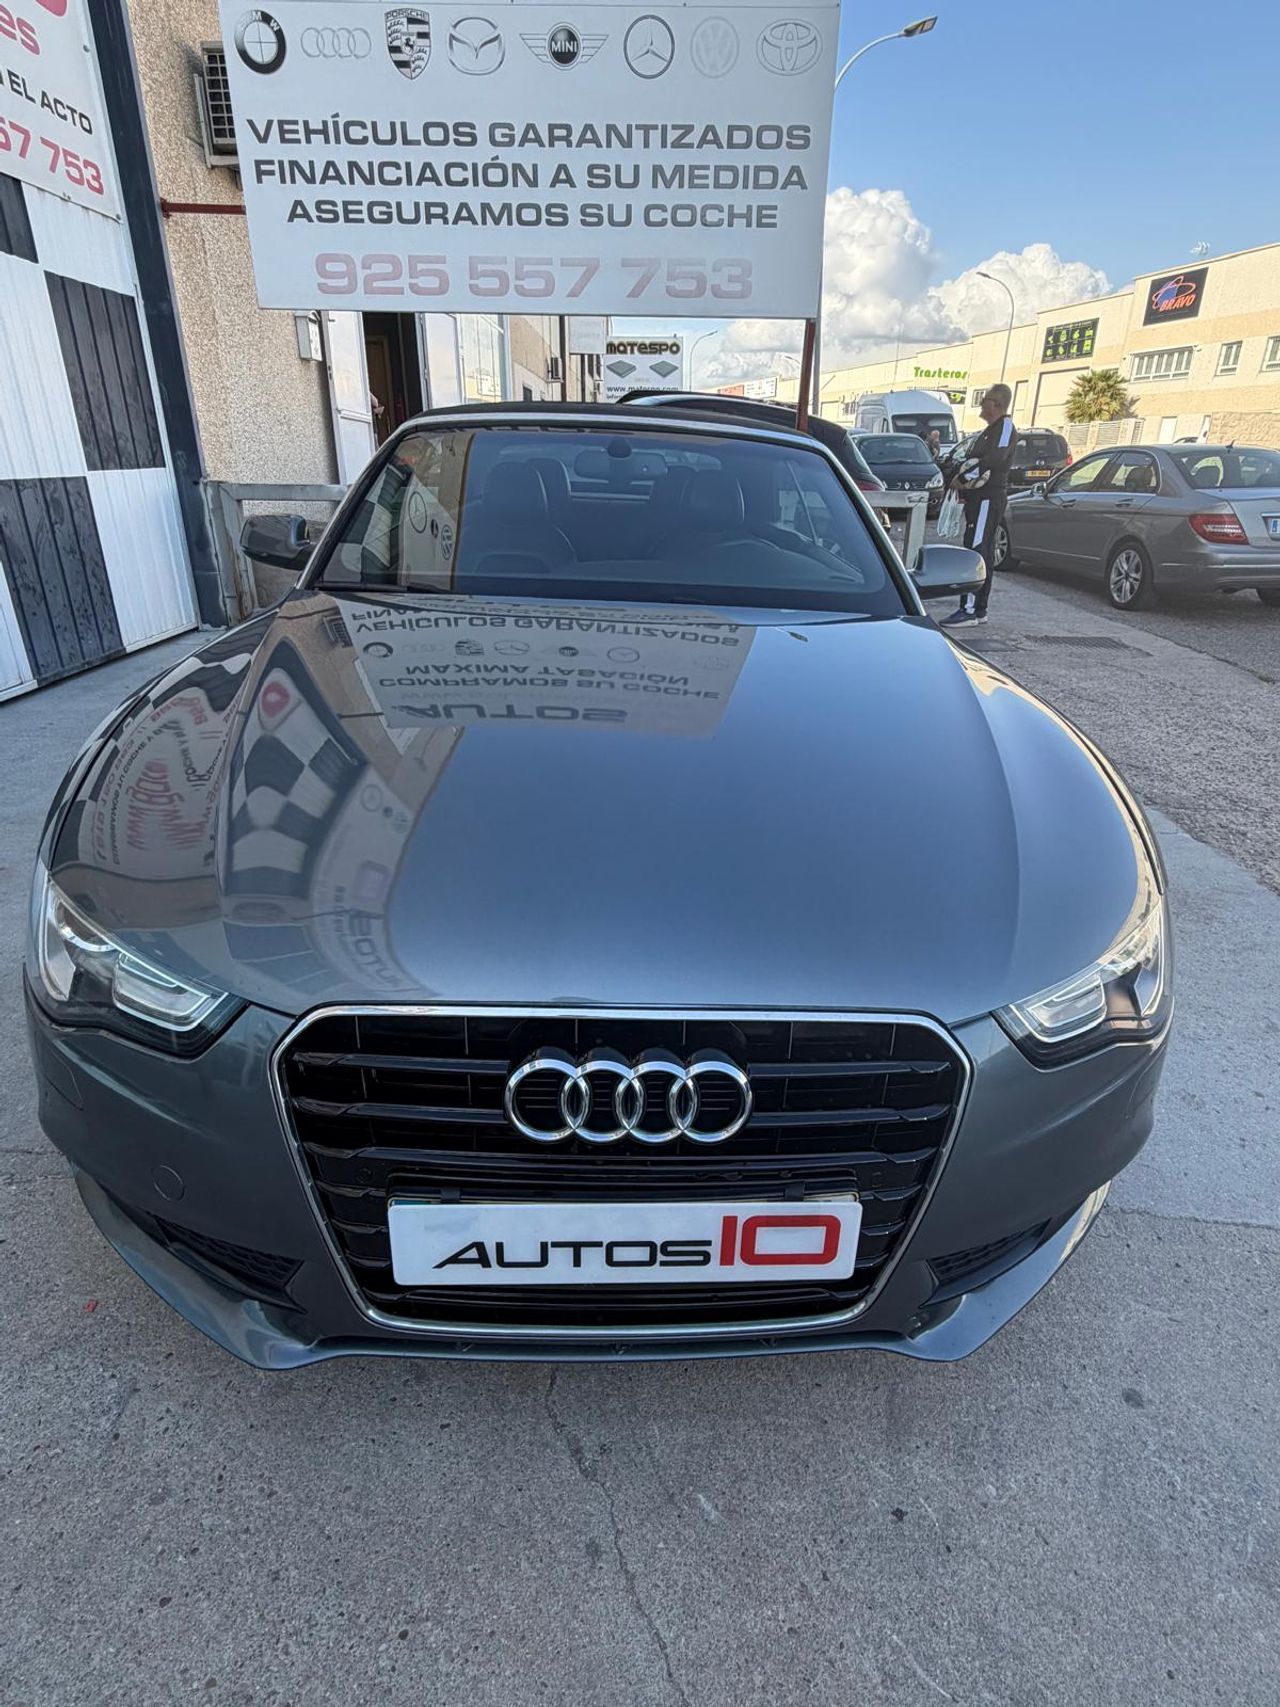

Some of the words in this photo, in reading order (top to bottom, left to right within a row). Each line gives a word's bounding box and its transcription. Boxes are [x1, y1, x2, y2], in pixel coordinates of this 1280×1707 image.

[551, 40, 578, 53] MINI
[7, 69, 36, 104] EL
[41, 90, 93, 135] ACTO
[247, 112, 478, 147] VEHÍCULOS
[488, 121, 811, 150] GARANTIZADOS
[40, 137, 104, 195] 753
[254, 154, 539, 188] FINANCIACIÓN
[549, 163, 577, 188] A
[587, 163, 640, 189] SU
[651, 164, 808, 190] MEDIDA
[287, 199, 570, 228] ASEGURAMOS
[579, 203, 632, 228] SU
[643, 203, 778, 229] COCHE
[315, 252, 450, 297] 925
[468, 255, 601, 299] 557
[620, 256, 753, 300] 753
[913, 366, 968, 380] Trasteros
